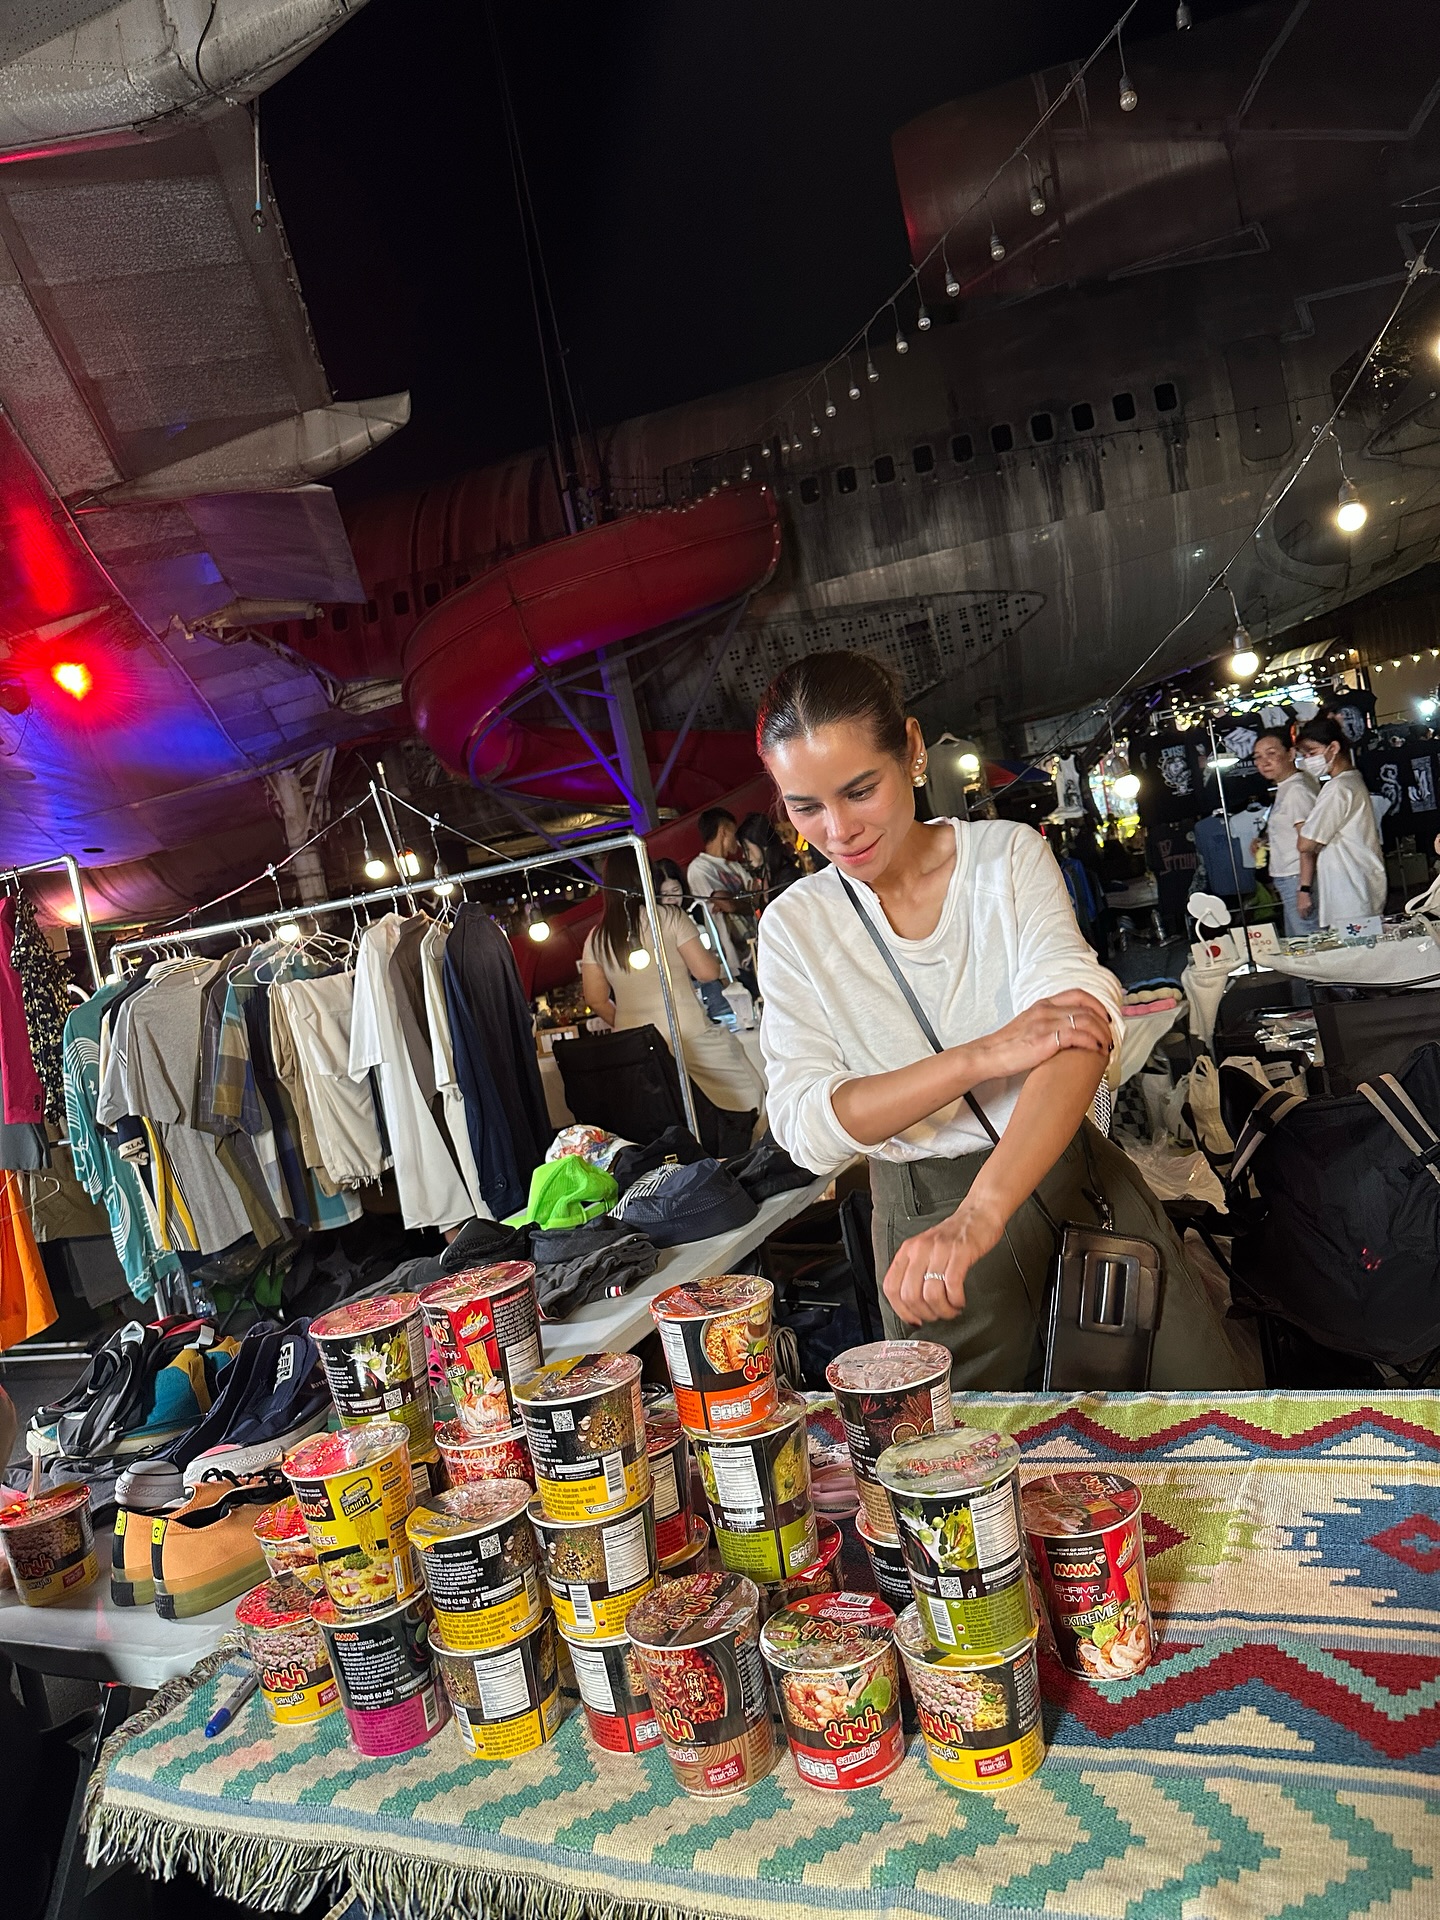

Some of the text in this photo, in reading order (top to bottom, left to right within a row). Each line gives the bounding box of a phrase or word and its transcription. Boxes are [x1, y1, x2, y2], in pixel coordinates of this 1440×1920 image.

[1054, 1562, 1101, 1578] MAMA
[1054, 1584, 1100, 1594] SHRIMP
[1056, 1590, 1116, 1603] TOM YUM
[1062, 1600, 1119, 1627] EXTREME
[263, 1661, 308, 1692] มาม่า
[824, 1707, 882, 1749] มาม่า
